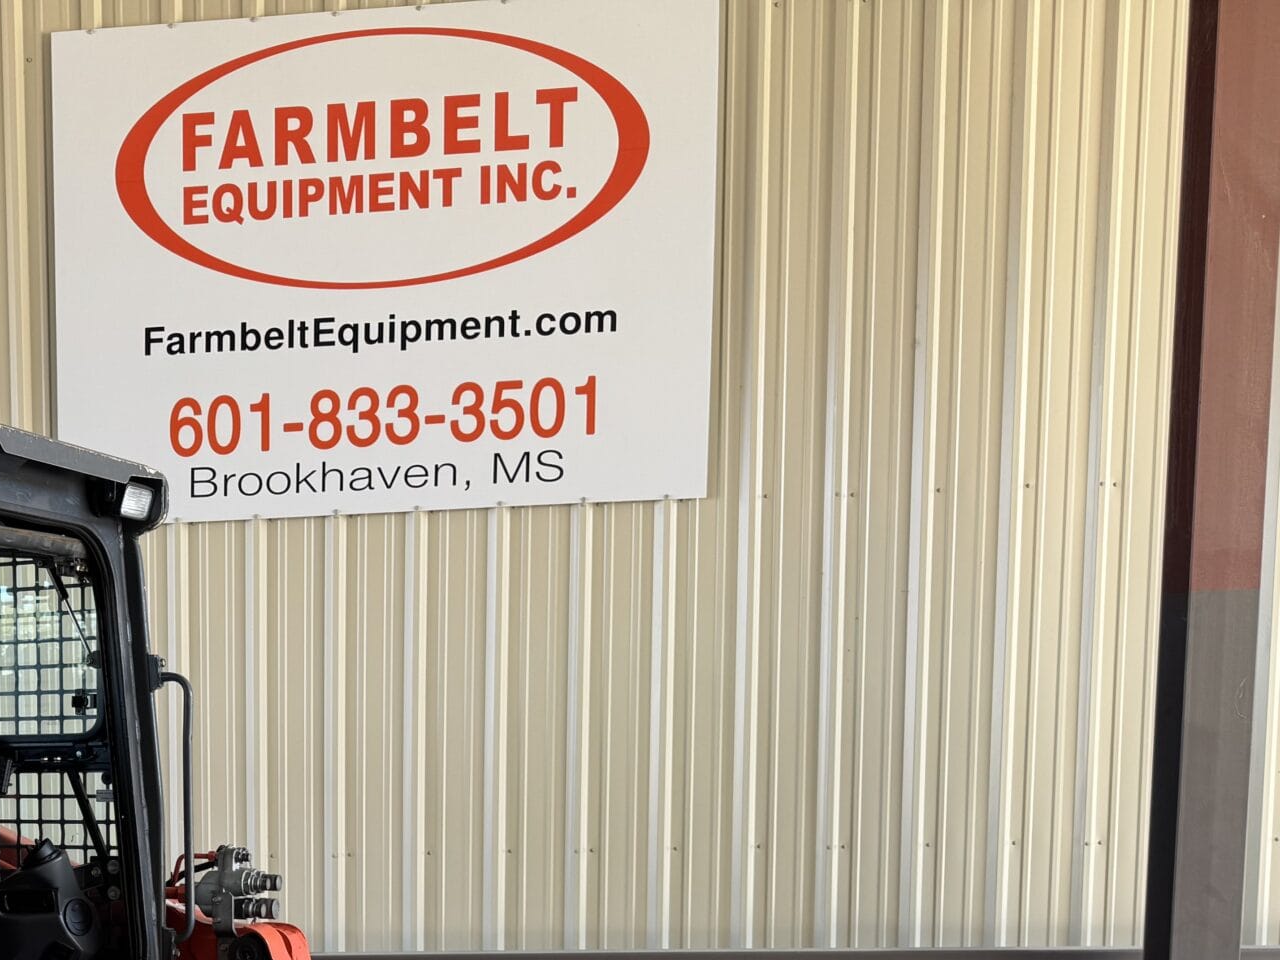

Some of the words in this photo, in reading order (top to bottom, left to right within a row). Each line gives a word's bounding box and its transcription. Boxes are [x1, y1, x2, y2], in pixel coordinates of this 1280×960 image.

[182, 87, 579, 172] FARMBELT
[183, 167, 463, 226] EQUIPMENT
[480, 160, 577, 206] INC.
[144, 309, 617, 356] FarmbeltEquipment.com
[169, 375, 597, 458] 601-833-3501
[190, 461, 472, 498] Brookhaven,
[492, 449, 565, 485] MS
